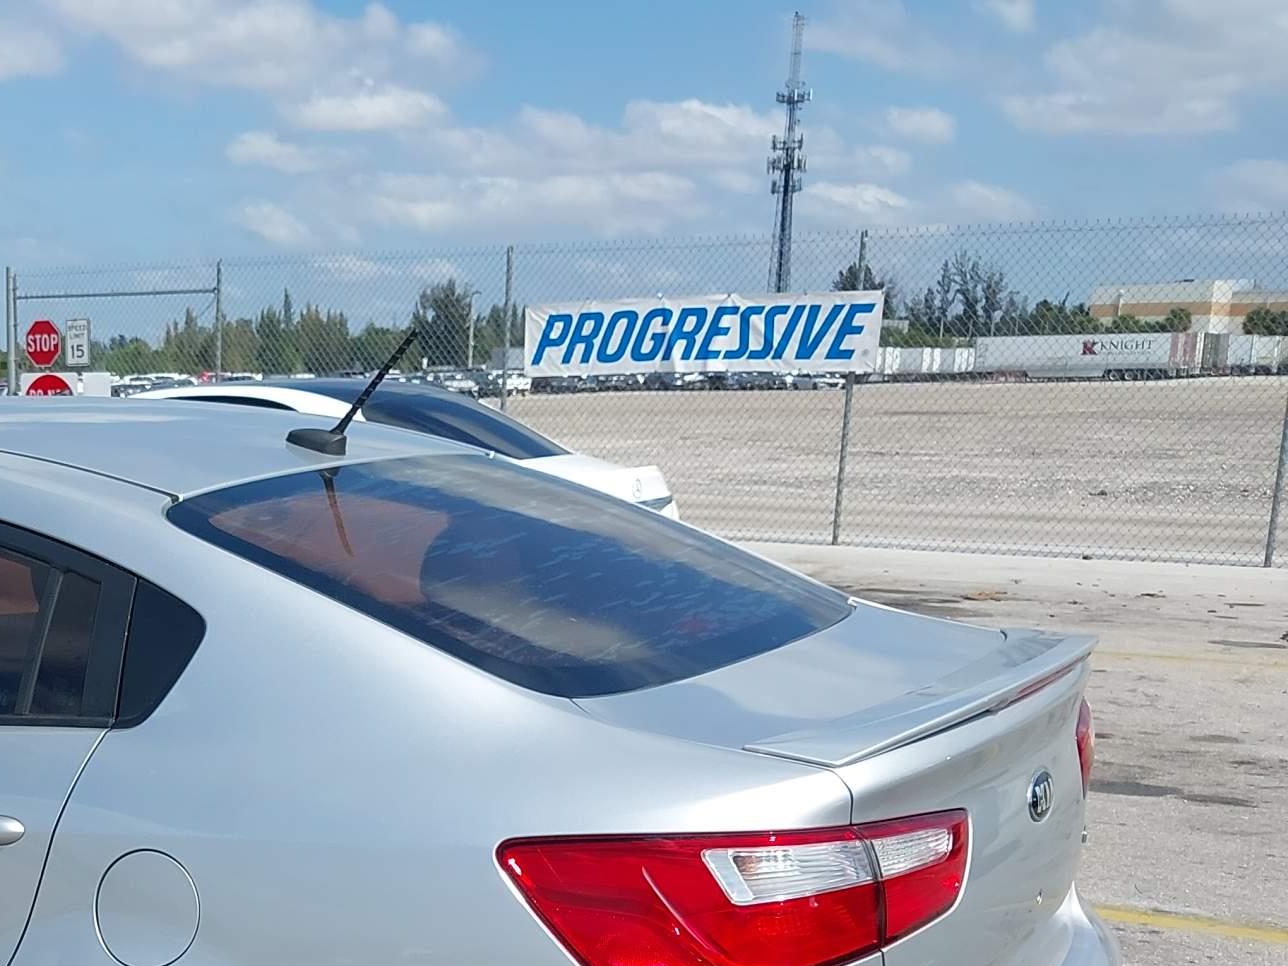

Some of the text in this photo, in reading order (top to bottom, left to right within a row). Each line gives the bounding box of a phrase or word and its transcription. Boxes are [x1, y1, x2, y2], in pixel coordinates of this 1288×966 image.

[27, 333, 58, 352] STOP
[531, 303, 878, 366] PROGRESSIVE
[71, 344, 85, 360] 15
[1100, 339, 1155, 351] KNIGHT
